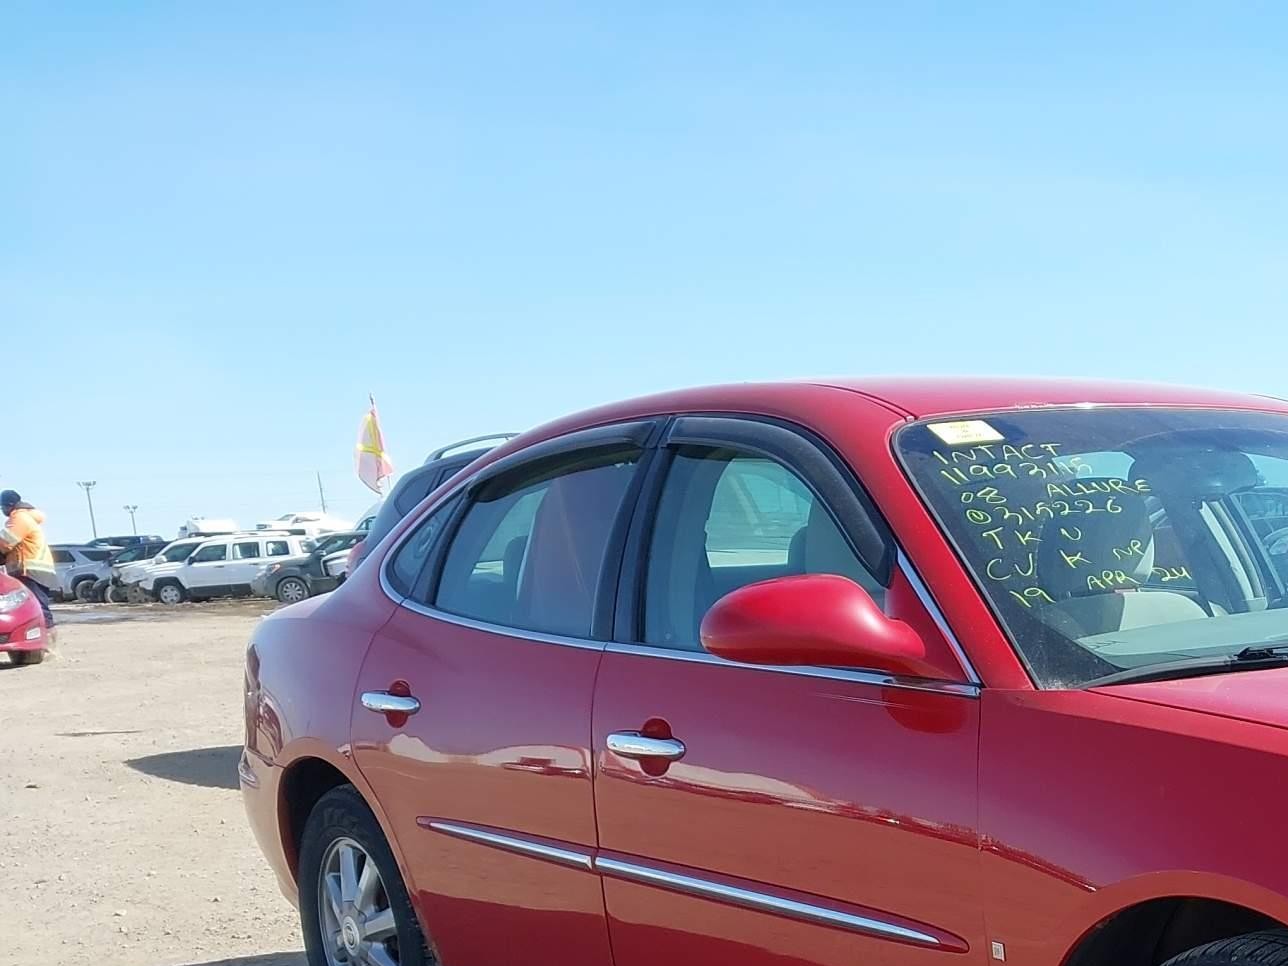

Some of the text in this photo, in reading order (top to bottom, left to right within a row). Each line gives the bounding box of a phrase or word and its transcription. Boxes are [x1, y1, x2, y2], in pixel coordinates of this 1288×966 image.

[932, 443, 1061, 465] INTACT
[940, 457, 1093, 486] 11993115
[1046, 479, 1151, 498] ALLURE
[1014, 530, 1043, 546] K
[1087, 570, 1142, 591] APR
[1151, 566, 1193, 582] 24
